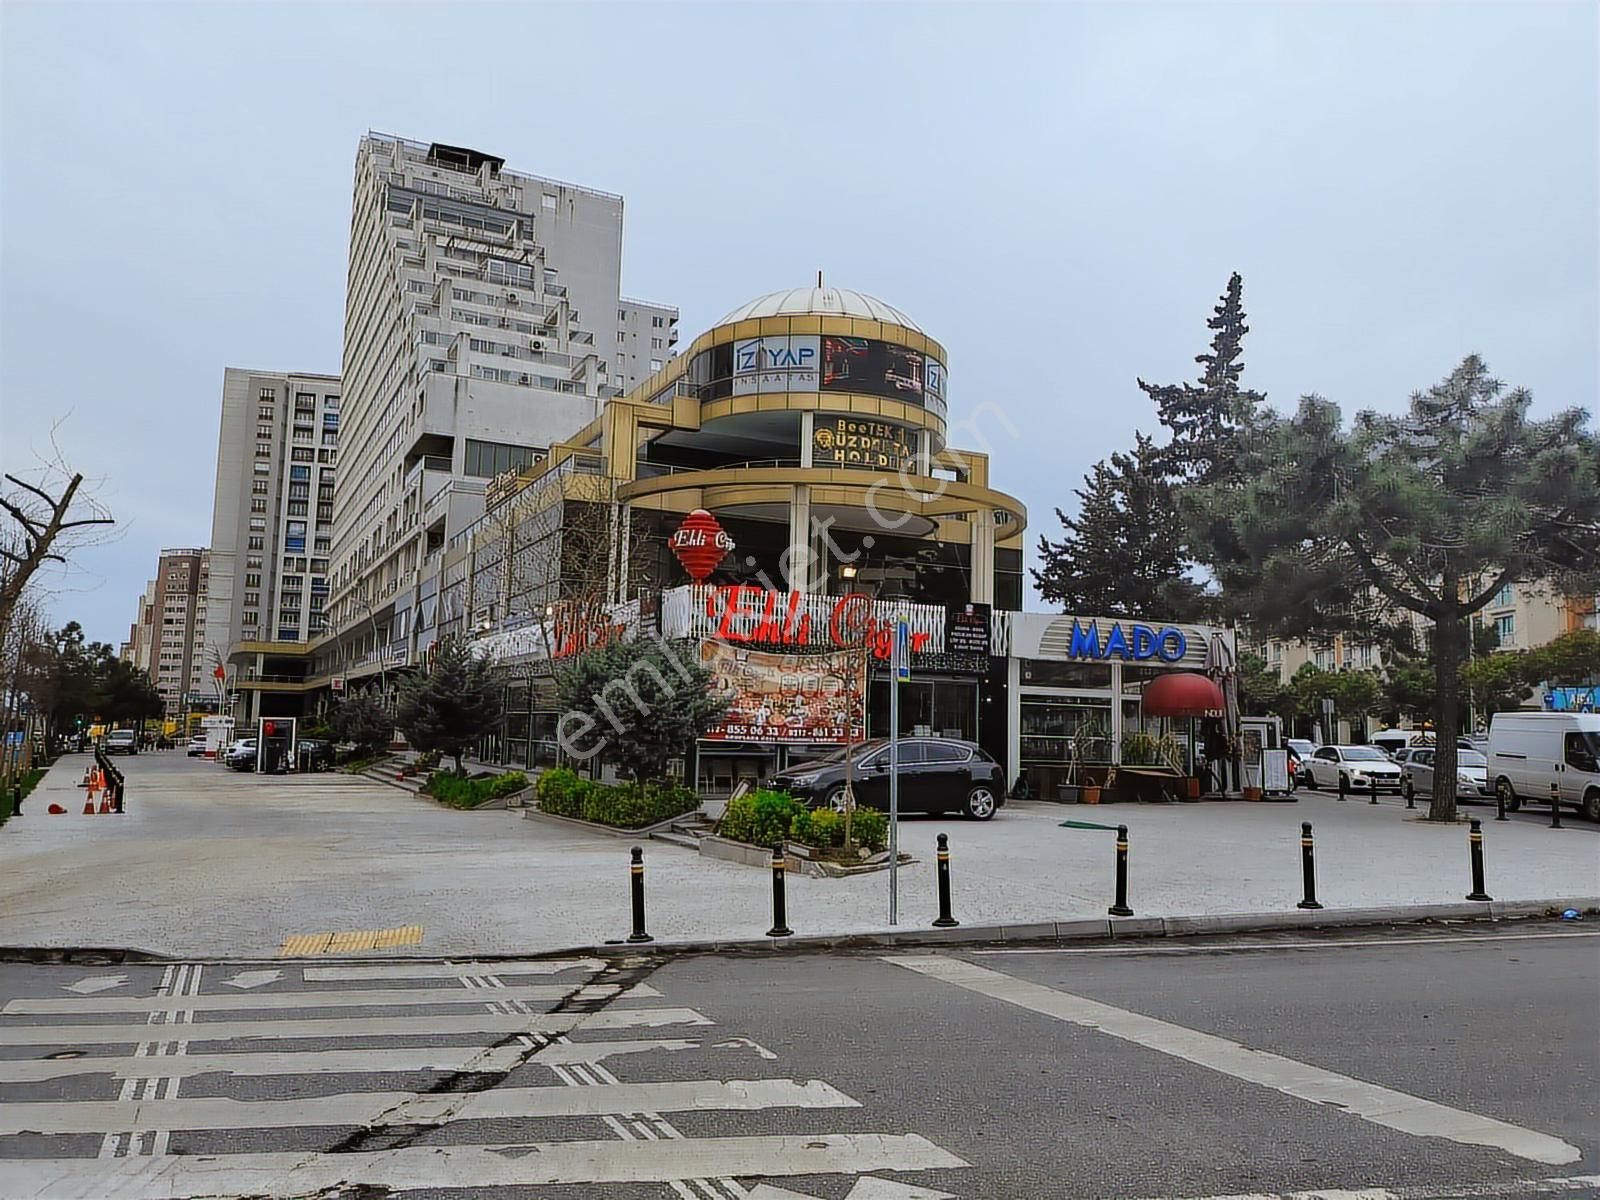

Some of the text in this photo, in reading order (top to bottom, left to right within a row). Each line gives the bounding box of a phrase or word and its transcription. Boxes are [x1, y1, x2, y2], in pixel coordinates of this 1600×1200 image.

[768, 348, 814, 367] YAP
[706, 585, 811, 647] Ehli
[1068, 617, 1187, 662] MADO
